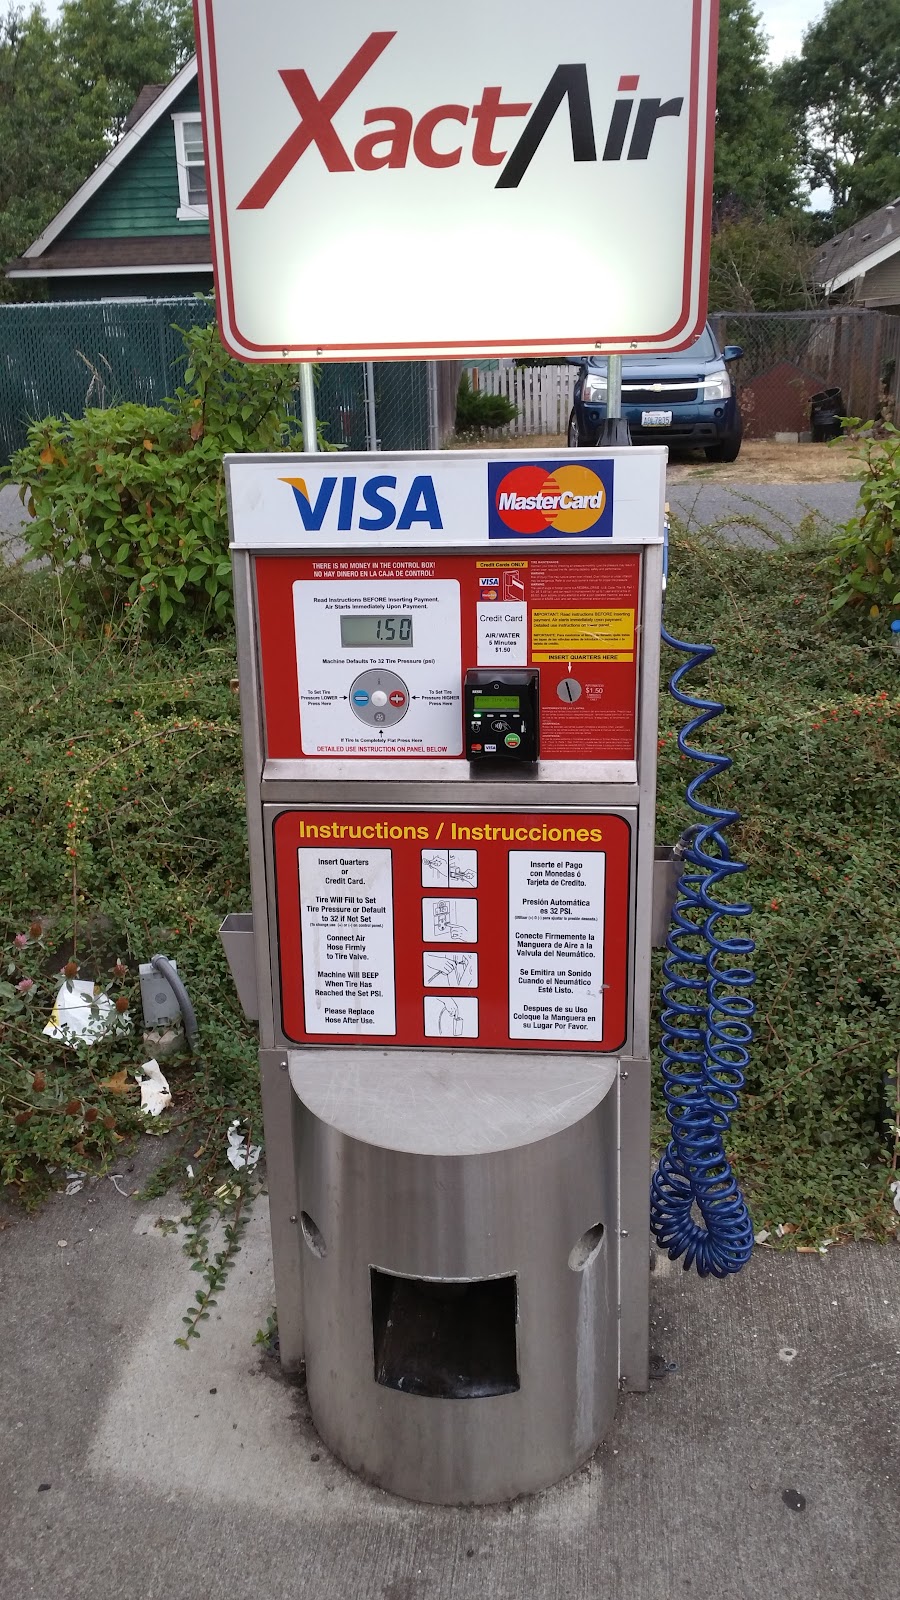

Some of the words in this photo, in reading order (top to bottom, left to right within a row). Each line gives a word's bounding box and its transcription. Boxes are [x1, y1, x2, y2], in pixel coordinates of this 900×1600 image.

[236, 31, 683, 210] XactAir
[277, 475, 443, 531] VISA
[498, 490, 602, 510] MasterCard
[377, 619, 411, 640] 1.50
[300, 821, 429, 839] Instructions
[435, 822, 444, 839] /
[451, 823, 602, 842] Instrucciones
[345, 944, 366, 952] Firmly
[517, 941, 551, 949] Manguera
[514, 1013, 540, 1021] Coloque
[551, 1014, 585, 1022] Manguera
[524, 1005, 552, 1013] Despues
